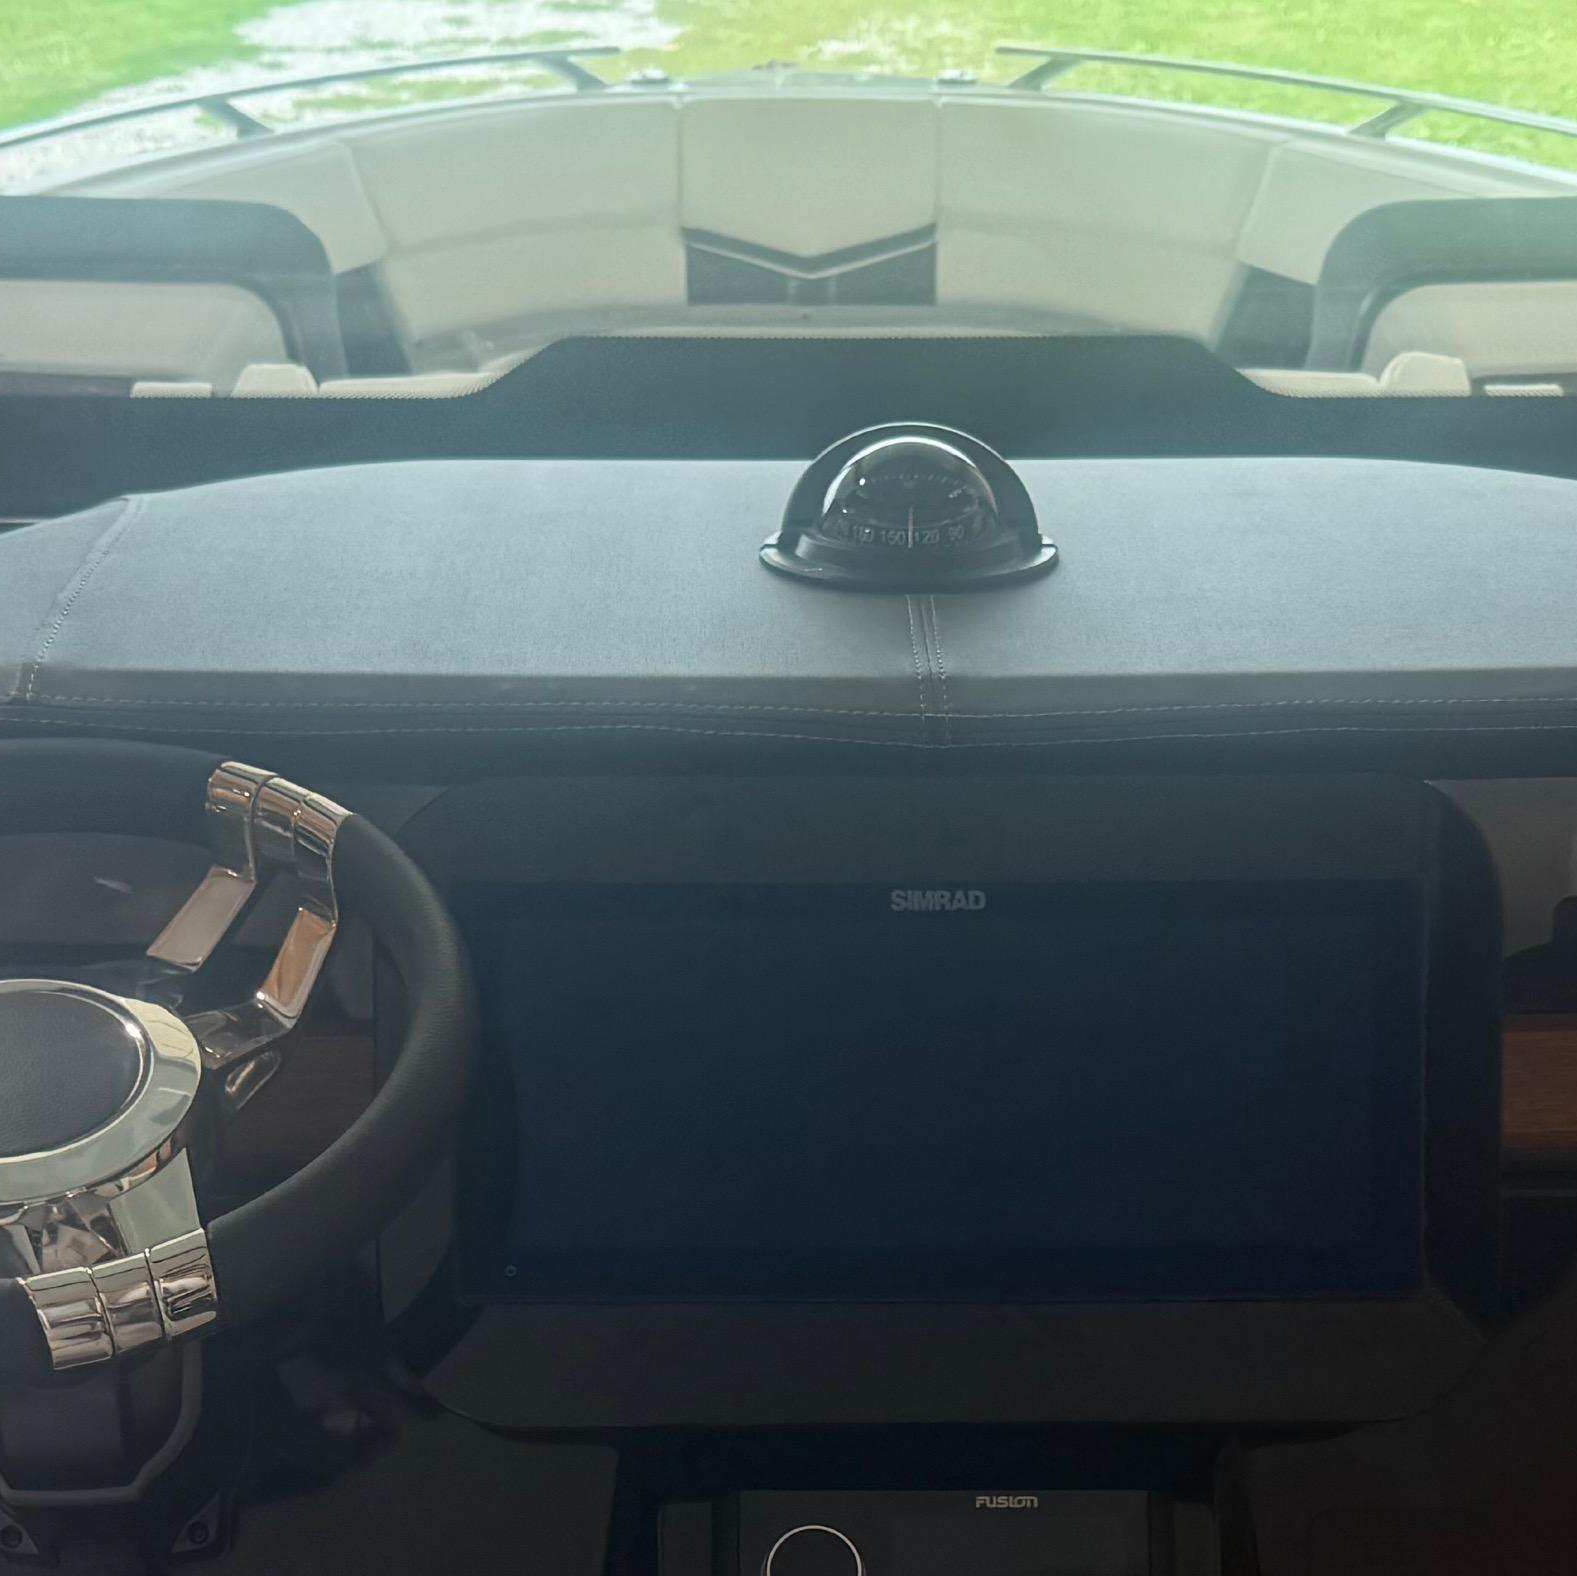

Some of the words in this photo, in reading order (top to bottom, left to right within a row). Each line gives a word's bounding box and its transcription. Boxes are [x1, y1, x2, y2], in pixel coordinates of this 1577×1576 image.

[880, 531, 906, 545] 150
[914, 529, 940, 544] 120
[948, 525, 965, 540] 90
[890, 890, 986, 911] SIMRAD
[976, 1496, 1038, 1508] FUSION
